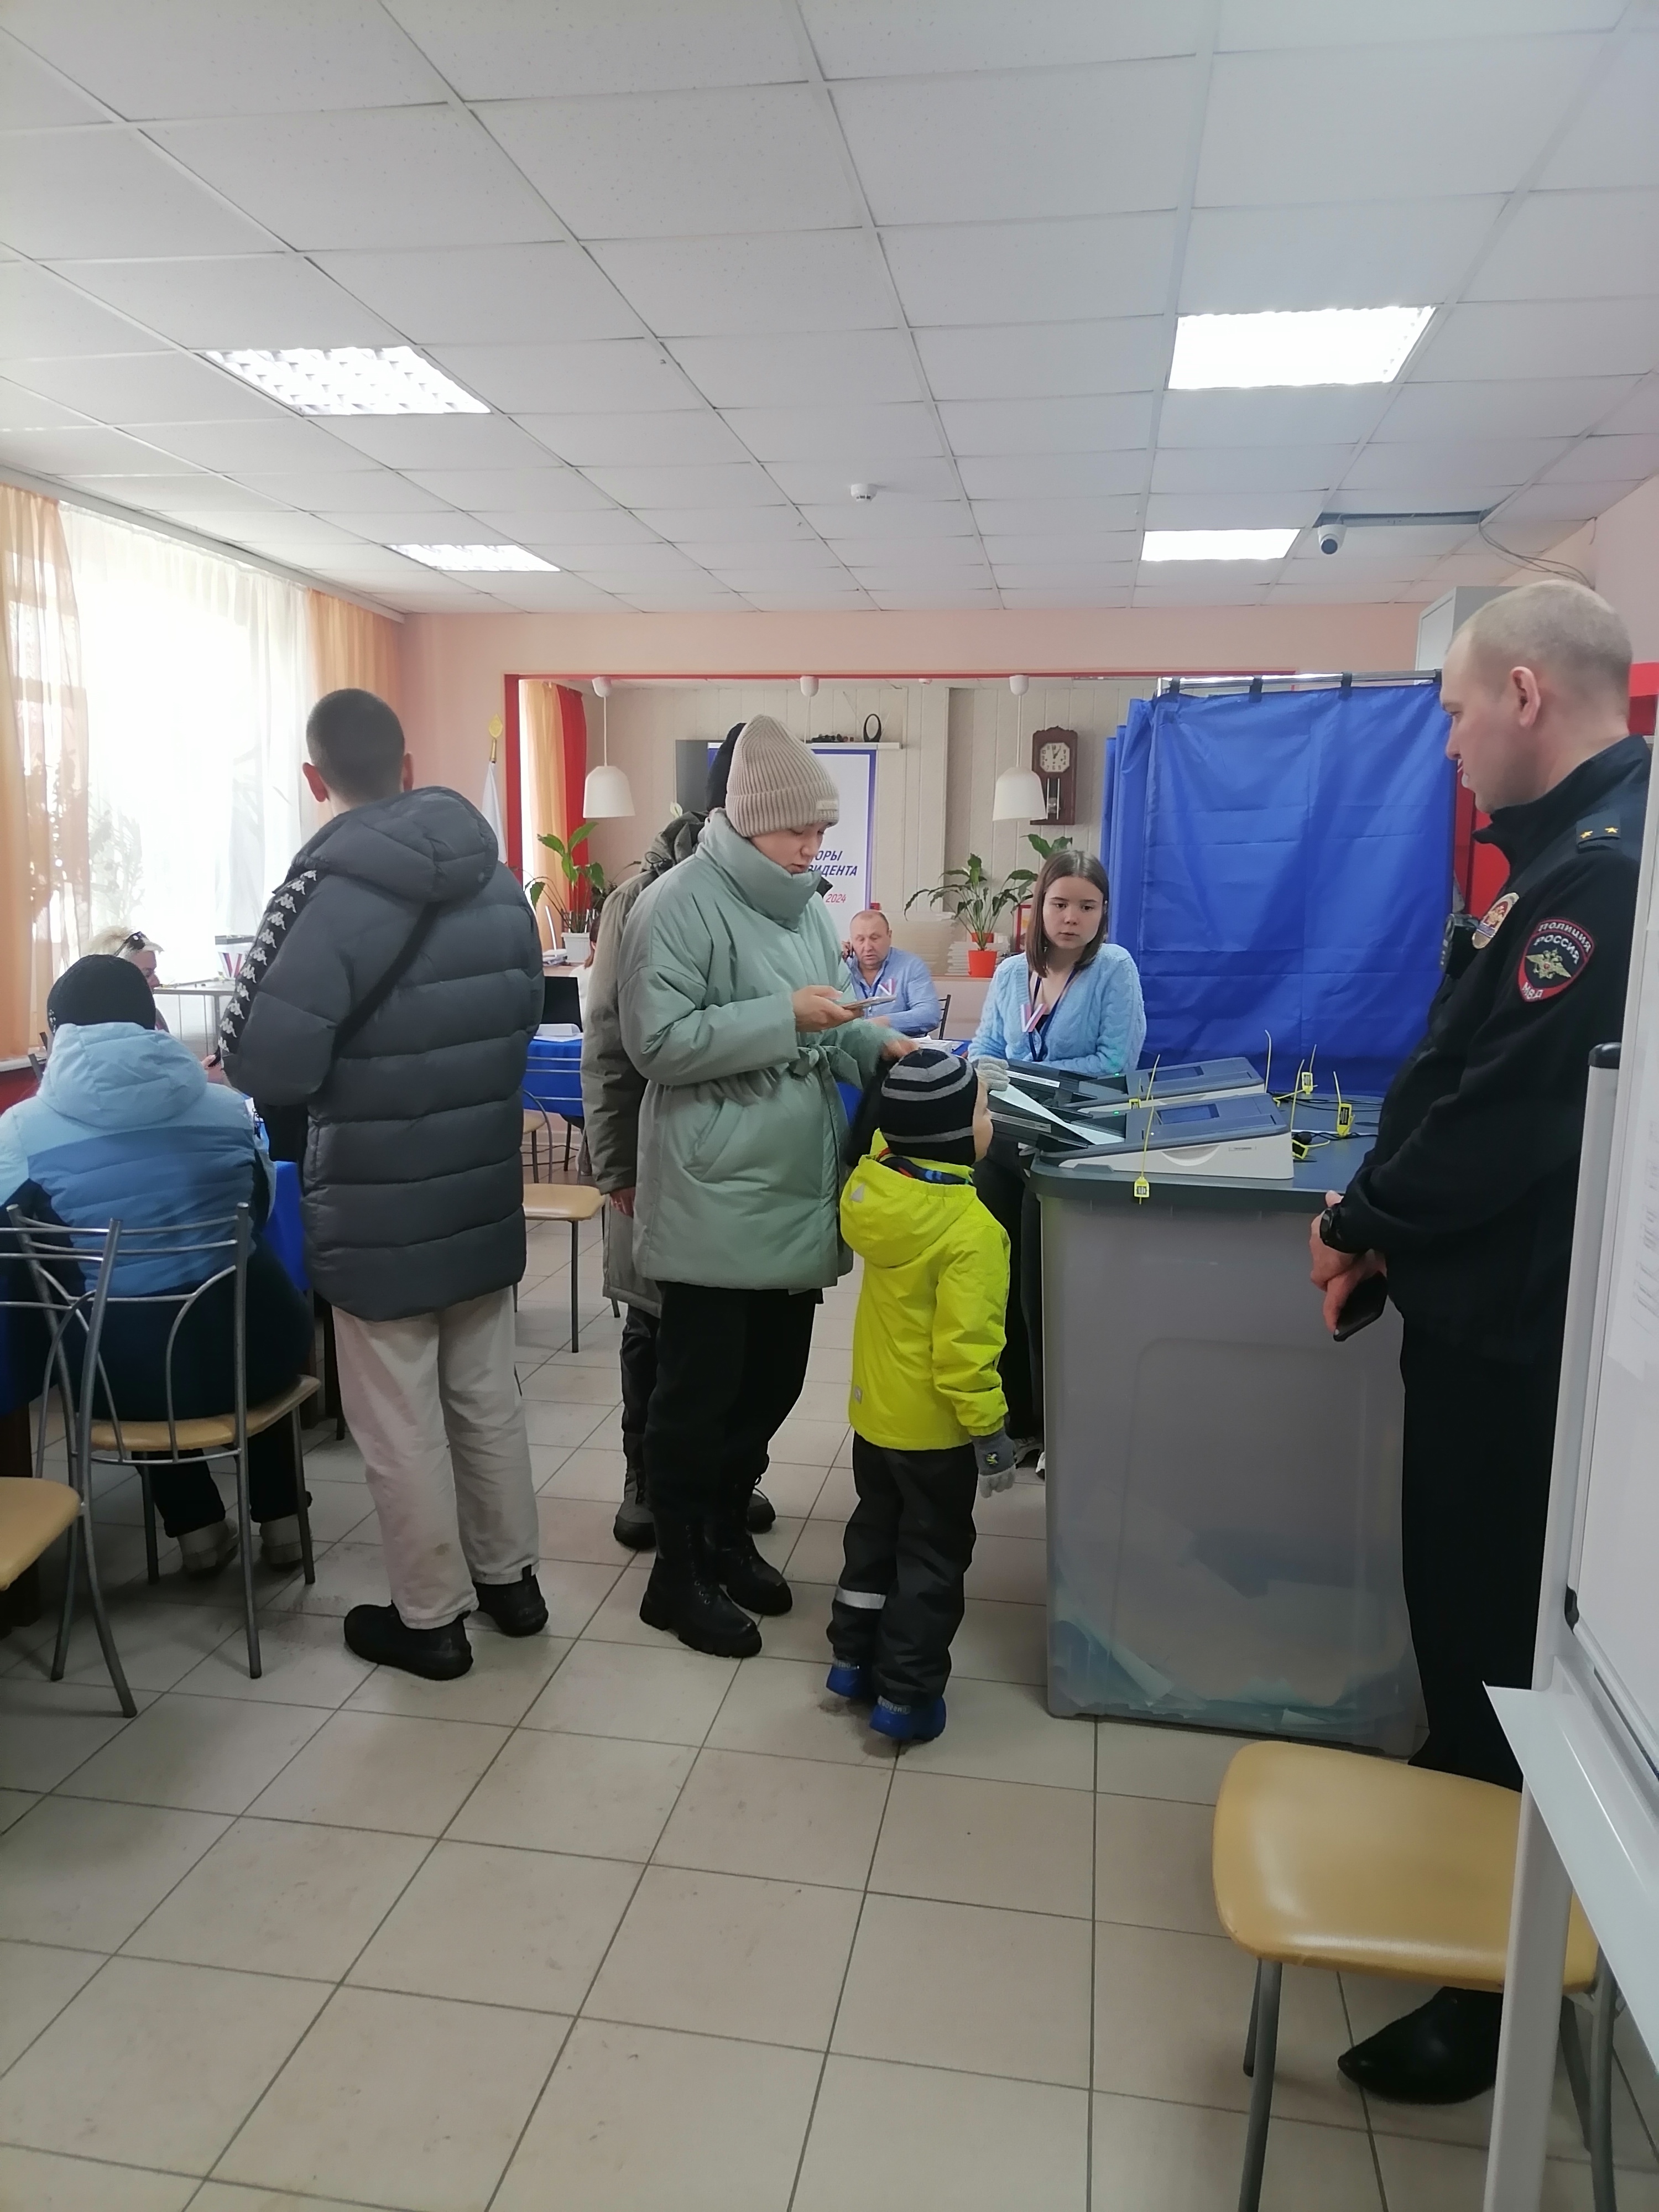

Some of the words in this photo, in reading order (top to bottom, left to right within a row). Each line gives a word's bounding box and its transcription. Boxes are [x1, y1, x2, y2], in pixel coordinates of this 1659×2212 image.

[815, 851, 843, 861] ОРЫ
[826, 894, 847, 903] 2024
[1538, 922, 1592, 953] ПОЛИЦИЯ
[1533, 935, 1579, 964] РОССИЯ
[1522, 982, 1544, 999] МВД
